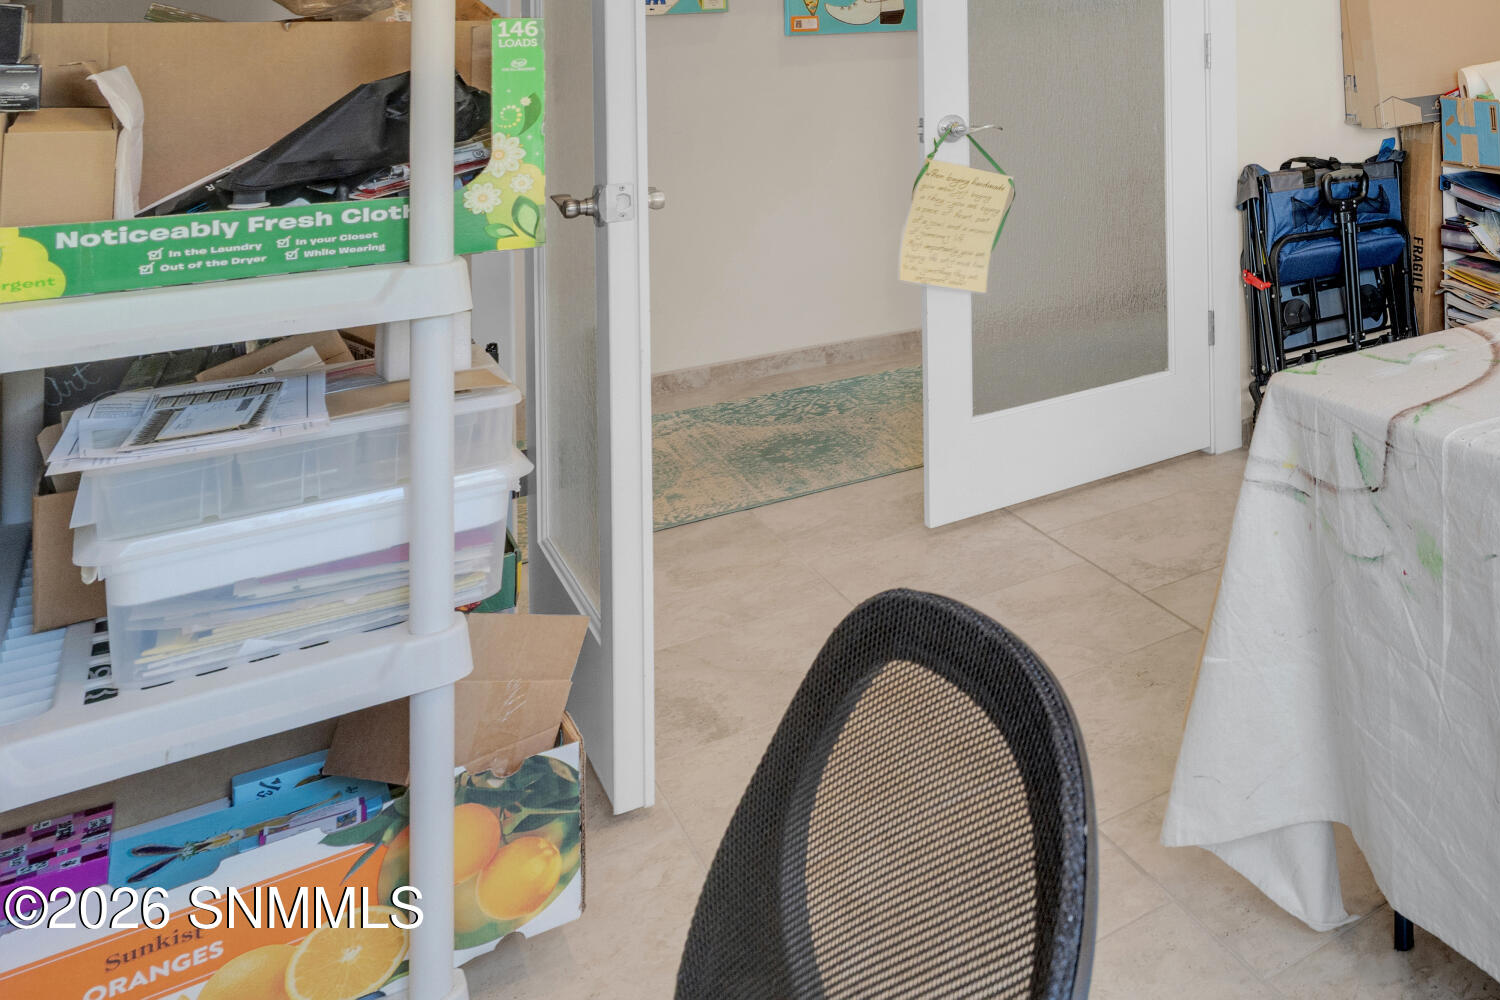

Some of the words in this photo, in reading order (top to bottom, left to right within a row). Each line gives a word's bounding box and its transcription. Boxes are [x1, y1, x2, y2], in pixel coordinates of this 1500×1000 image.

[497, 20, 539, 37] 146
[498, 38, 539, 48] LOADS
[55, 219, 240, 249] Noticeably
[247, 211, 333, 233] Fresh
[295, 238, 309, 246] In
[310, 236, 337, 246] your
[339, 232, 379, 242] Closet
[169, 249, 181, 258] In
[184, 248, 207, 256] the
[210, 242, 262, 254] Laundry
[304, 248, 336, 258] While
[338, 243, 386, 255] Wearing
[160, 263, 185, 272] Out
[188, 261, 203, 269] of
[205, 259, 228, 268] the
[231, 255, 267, 266] Dryer
[1412, 236, 1424, 294] FRAGILE
[104, 926, 204, 972] Sunkist
[82, 939, 225, 1000] ORANGES
